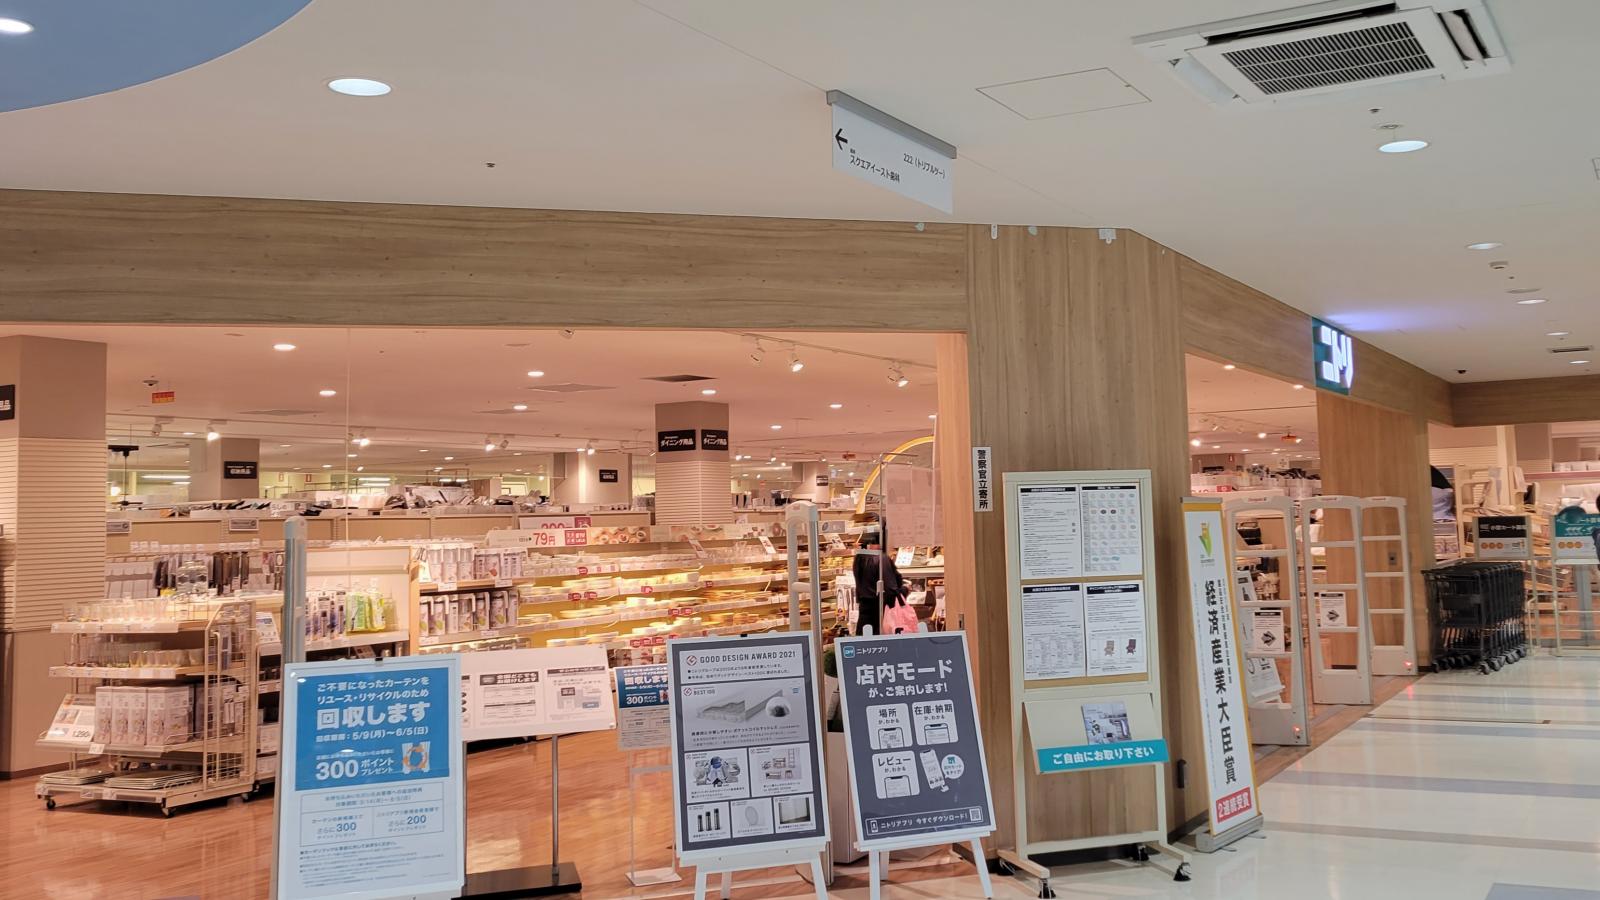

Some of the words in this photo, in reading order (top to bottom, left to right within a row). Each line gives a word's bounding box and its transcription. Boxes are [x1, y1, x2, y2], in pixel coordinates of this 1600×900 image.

[1321, 325, 1354, 388] ニトリ
[660, 437, 694, 448] ダイニング用品
[977, 449, 989, 509] 警察官立寄所
[700, 655, 720, 664] GOOD
[722, 653, 749, 663] DESIGN
[751, 651, 778, 661] AWARD
[779, 650, 796, 659] 2021
[856, 646, 888, 655] ニトリアプリ
[856, 659, 953, 686] 店内モード
[317, 676, 430, 693] ご不要になったカーテンを
[1205, 580, 1237, 785] 経済産業大臣賞
[317, 689, 430, 705] リユース・リサイクルのため
[626, 696, 643, 705] 300
[316, 701, 431, 730] 回収します
[878, 708, 898, 718] 場所
[914, 703, 953, 716] 在庫・納期
[878, 756, 912, 767] レビュー
[1053, 747, 1155, 765] ご自由にお取り下さい
[315, 759, 359, 780] 300
[361, 757, 395, 768] ポイント
[360, 766, 394, 777] プレゼント
[407, 814, 427, 825] 200
[880, 819, 913, 829] ニトリアプリ
[336, 822, 357, 832] 300
